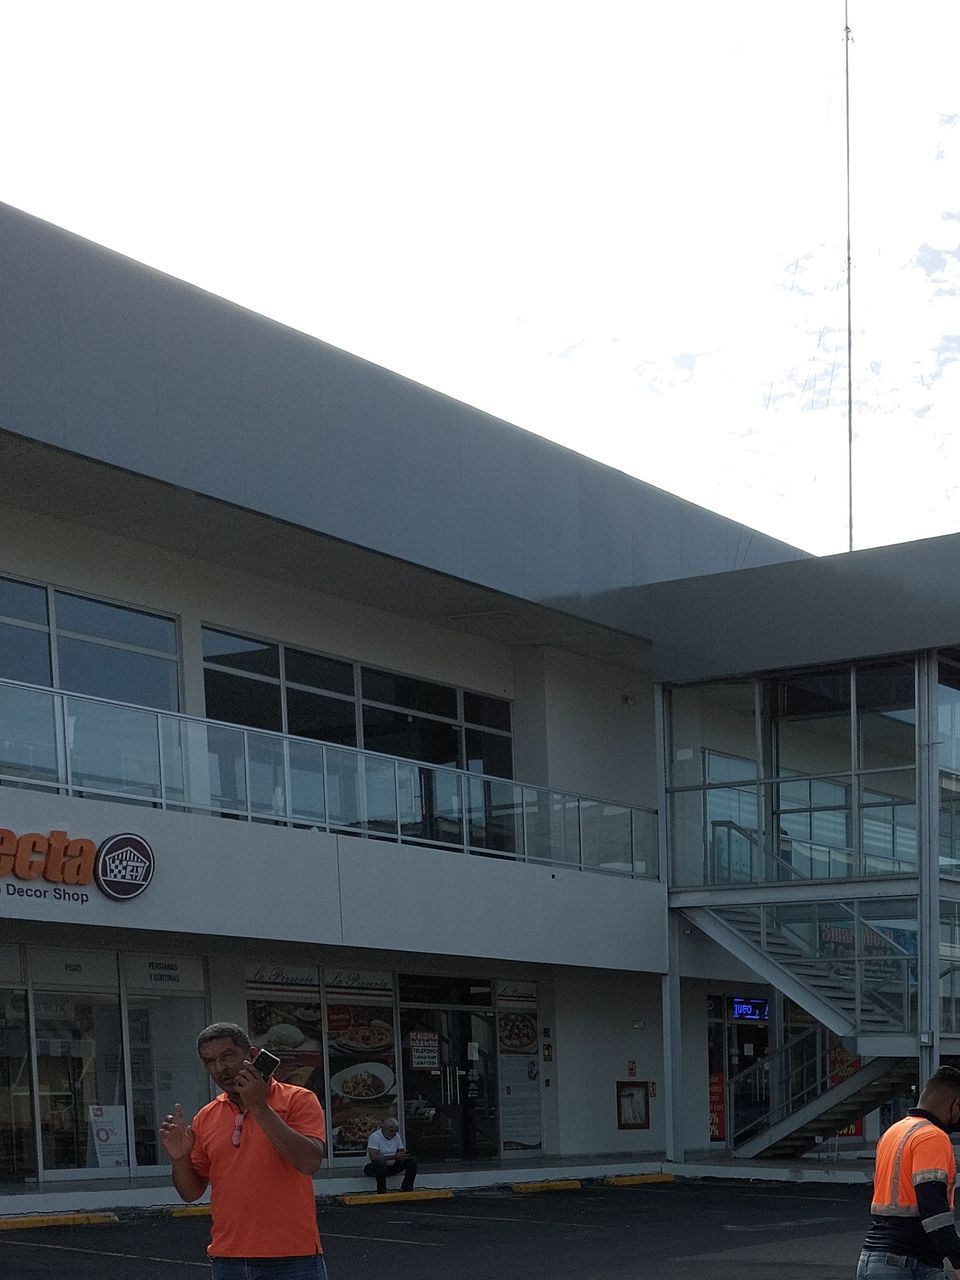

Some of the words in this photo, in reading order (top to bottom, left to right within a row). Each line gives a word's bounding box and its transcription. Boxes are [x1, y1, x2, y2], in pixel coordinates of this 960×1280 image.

[6, 883, 49, 899] Decor
[53, 887, 89, 905] Shop
[148, 961, 178, 972] PERSIANAS
